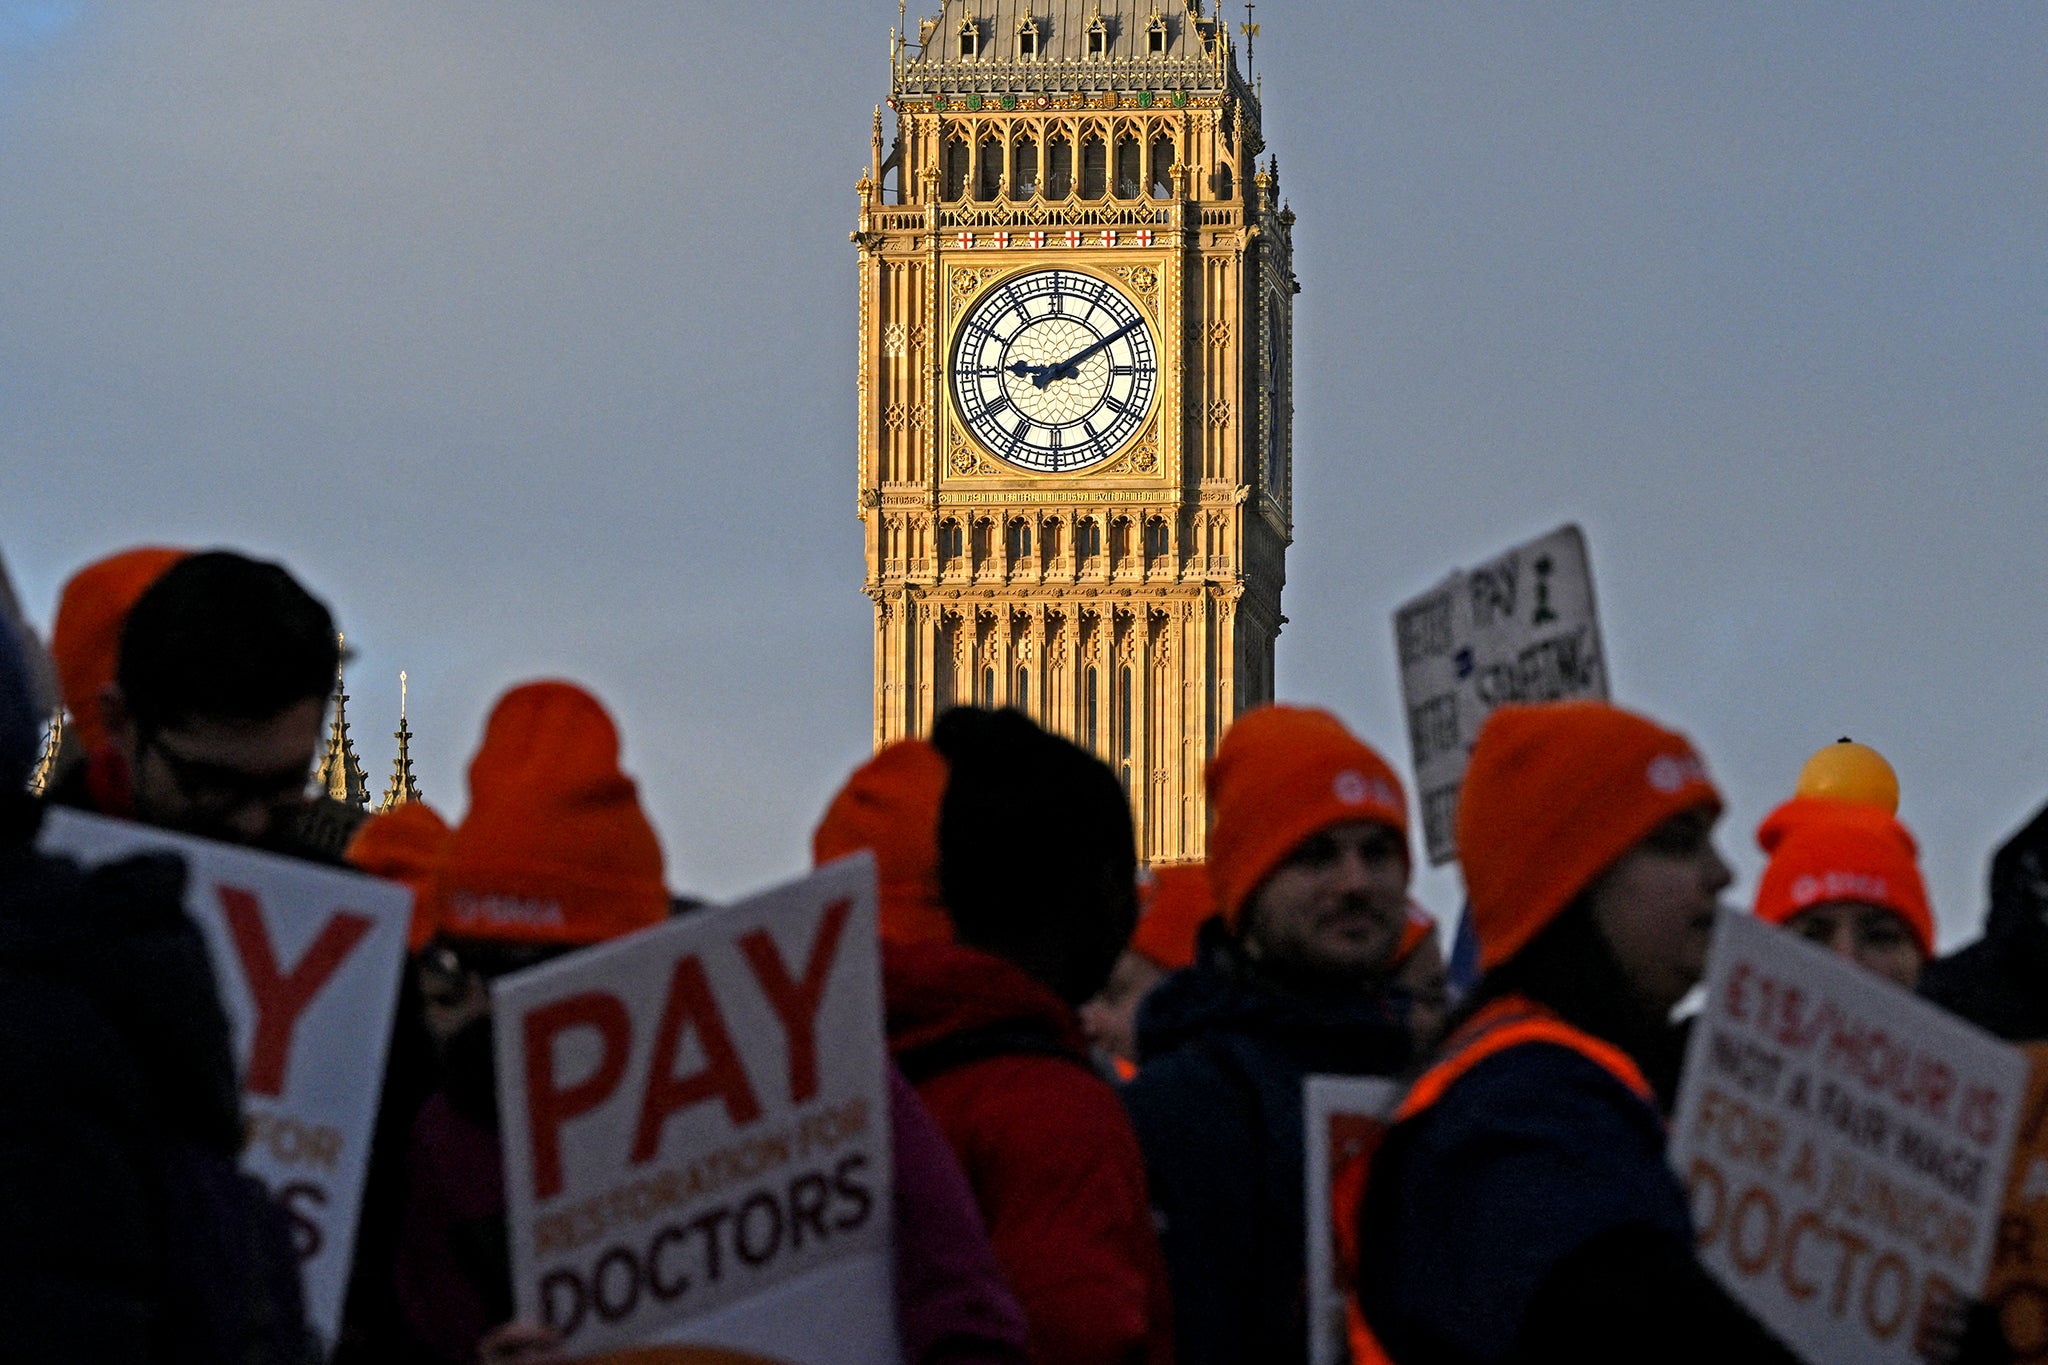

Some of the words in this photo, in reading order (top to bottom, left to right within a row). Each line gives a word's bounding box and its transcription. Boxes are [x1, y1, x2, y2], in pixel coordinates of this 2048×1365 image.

[522, 897, 853, 1200] PAY
[1711, 1030, 1785, 1097] NOT
[1785, 1070, 1812, 1109] A
[1818, 1079, 1889, 1155] FAIR
[1897, 1126, 1988, 1203] WAGE
[534, 1138, 789, 1257] RESTORATION
[799, 1099, 870, 1154] FOR
[1698, 1087, 1786, 1162] FOR
[1790, 1139, 1818, 1195] A
[539, 1154, 873, 1338] DOCTORS
